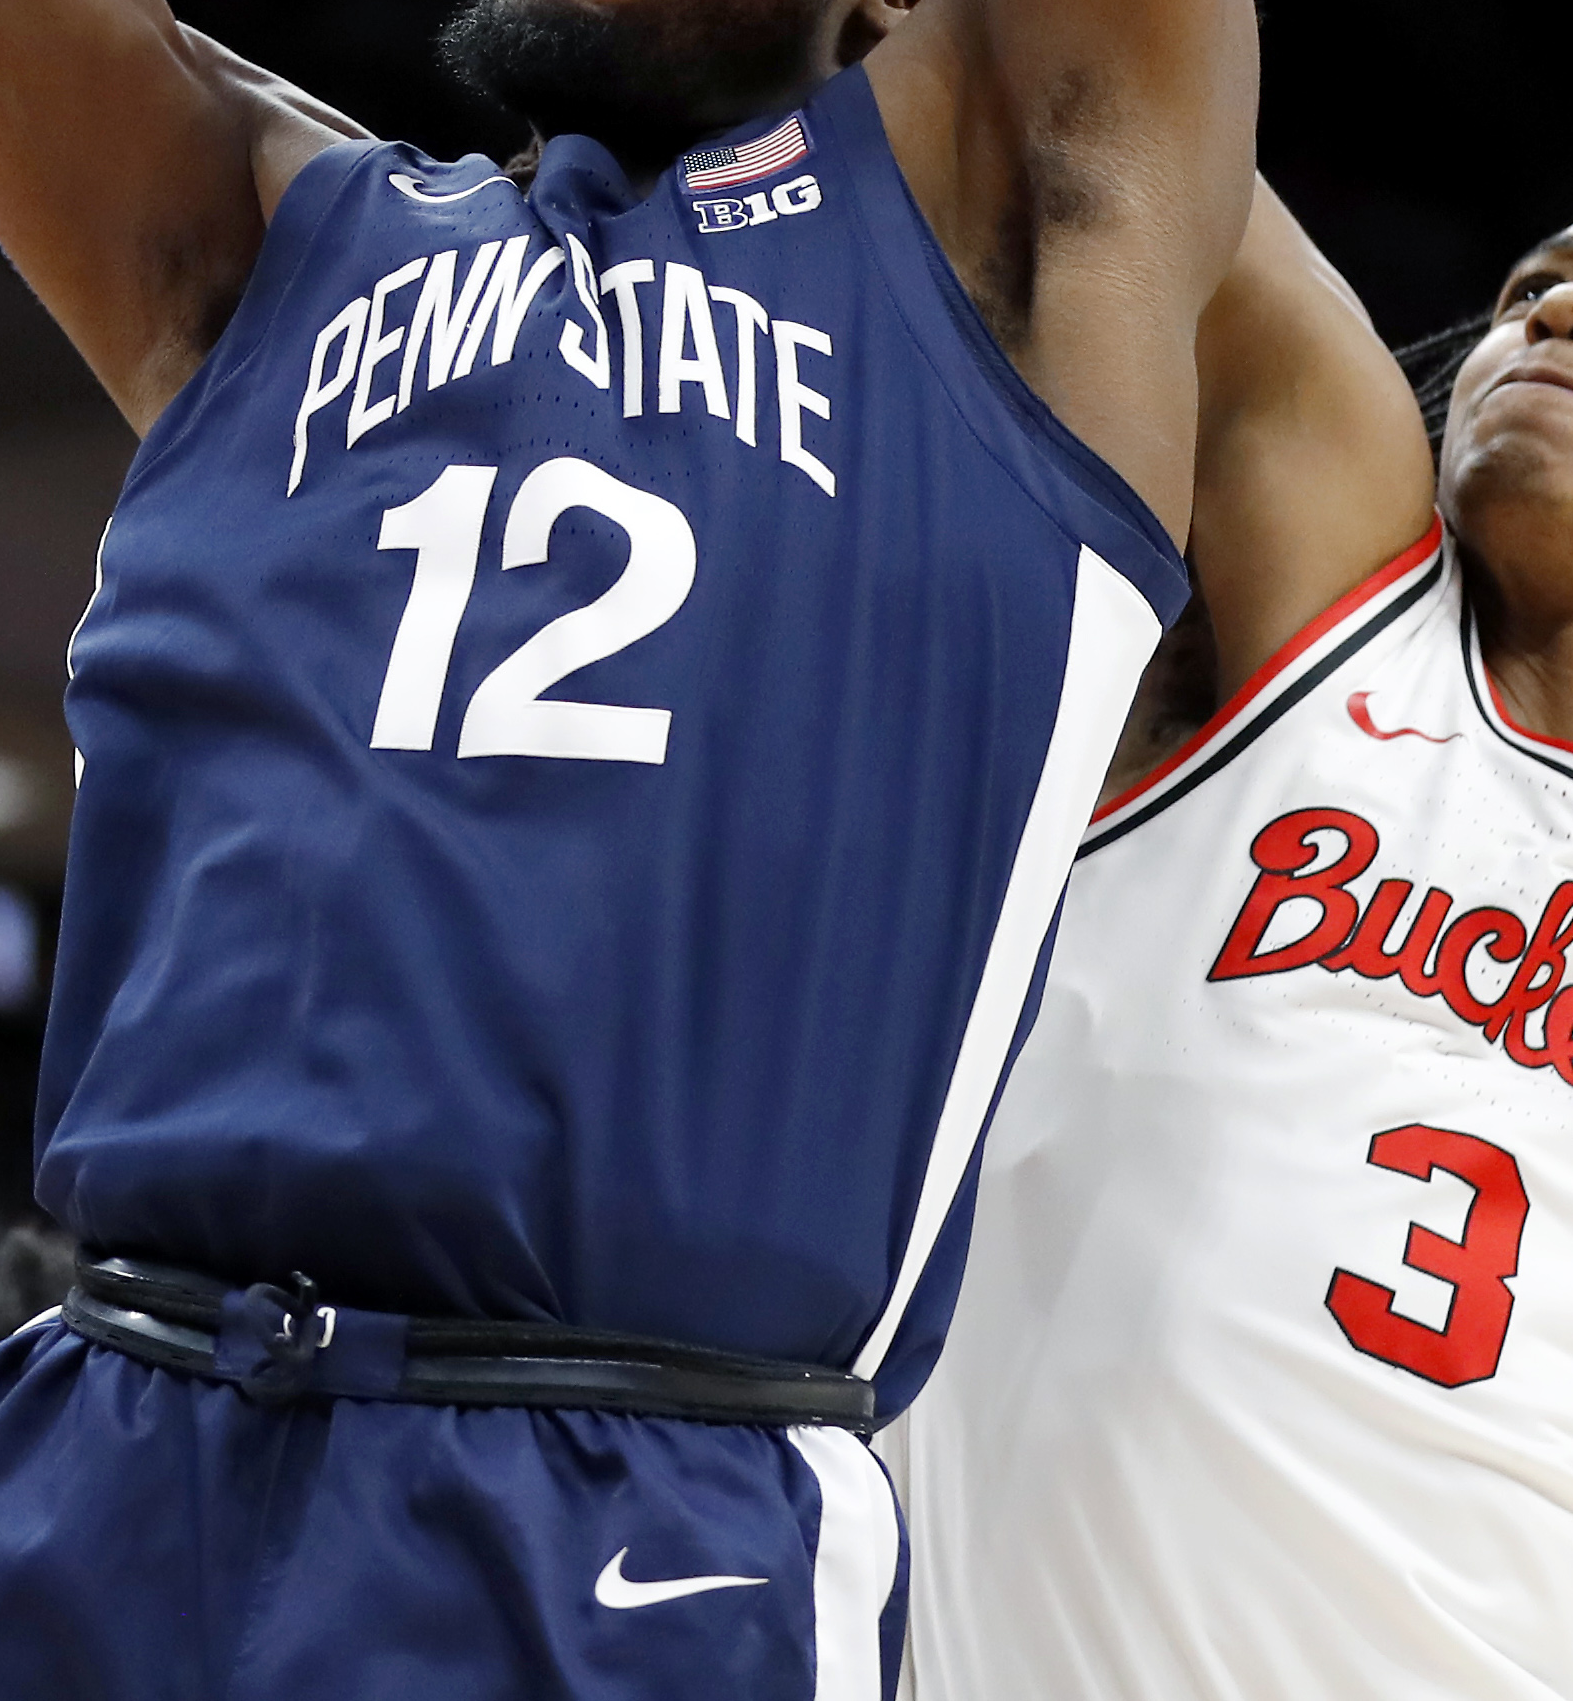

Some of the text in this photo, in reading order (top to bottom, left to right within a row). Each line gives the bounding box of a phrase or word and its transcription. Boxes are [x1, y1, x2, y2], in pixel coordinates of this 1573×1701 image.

[287, 232, 836, 498] PENN STATE
[370, 456, 697, 765] 12
[1324, 1123, 1531, 1389] 3
